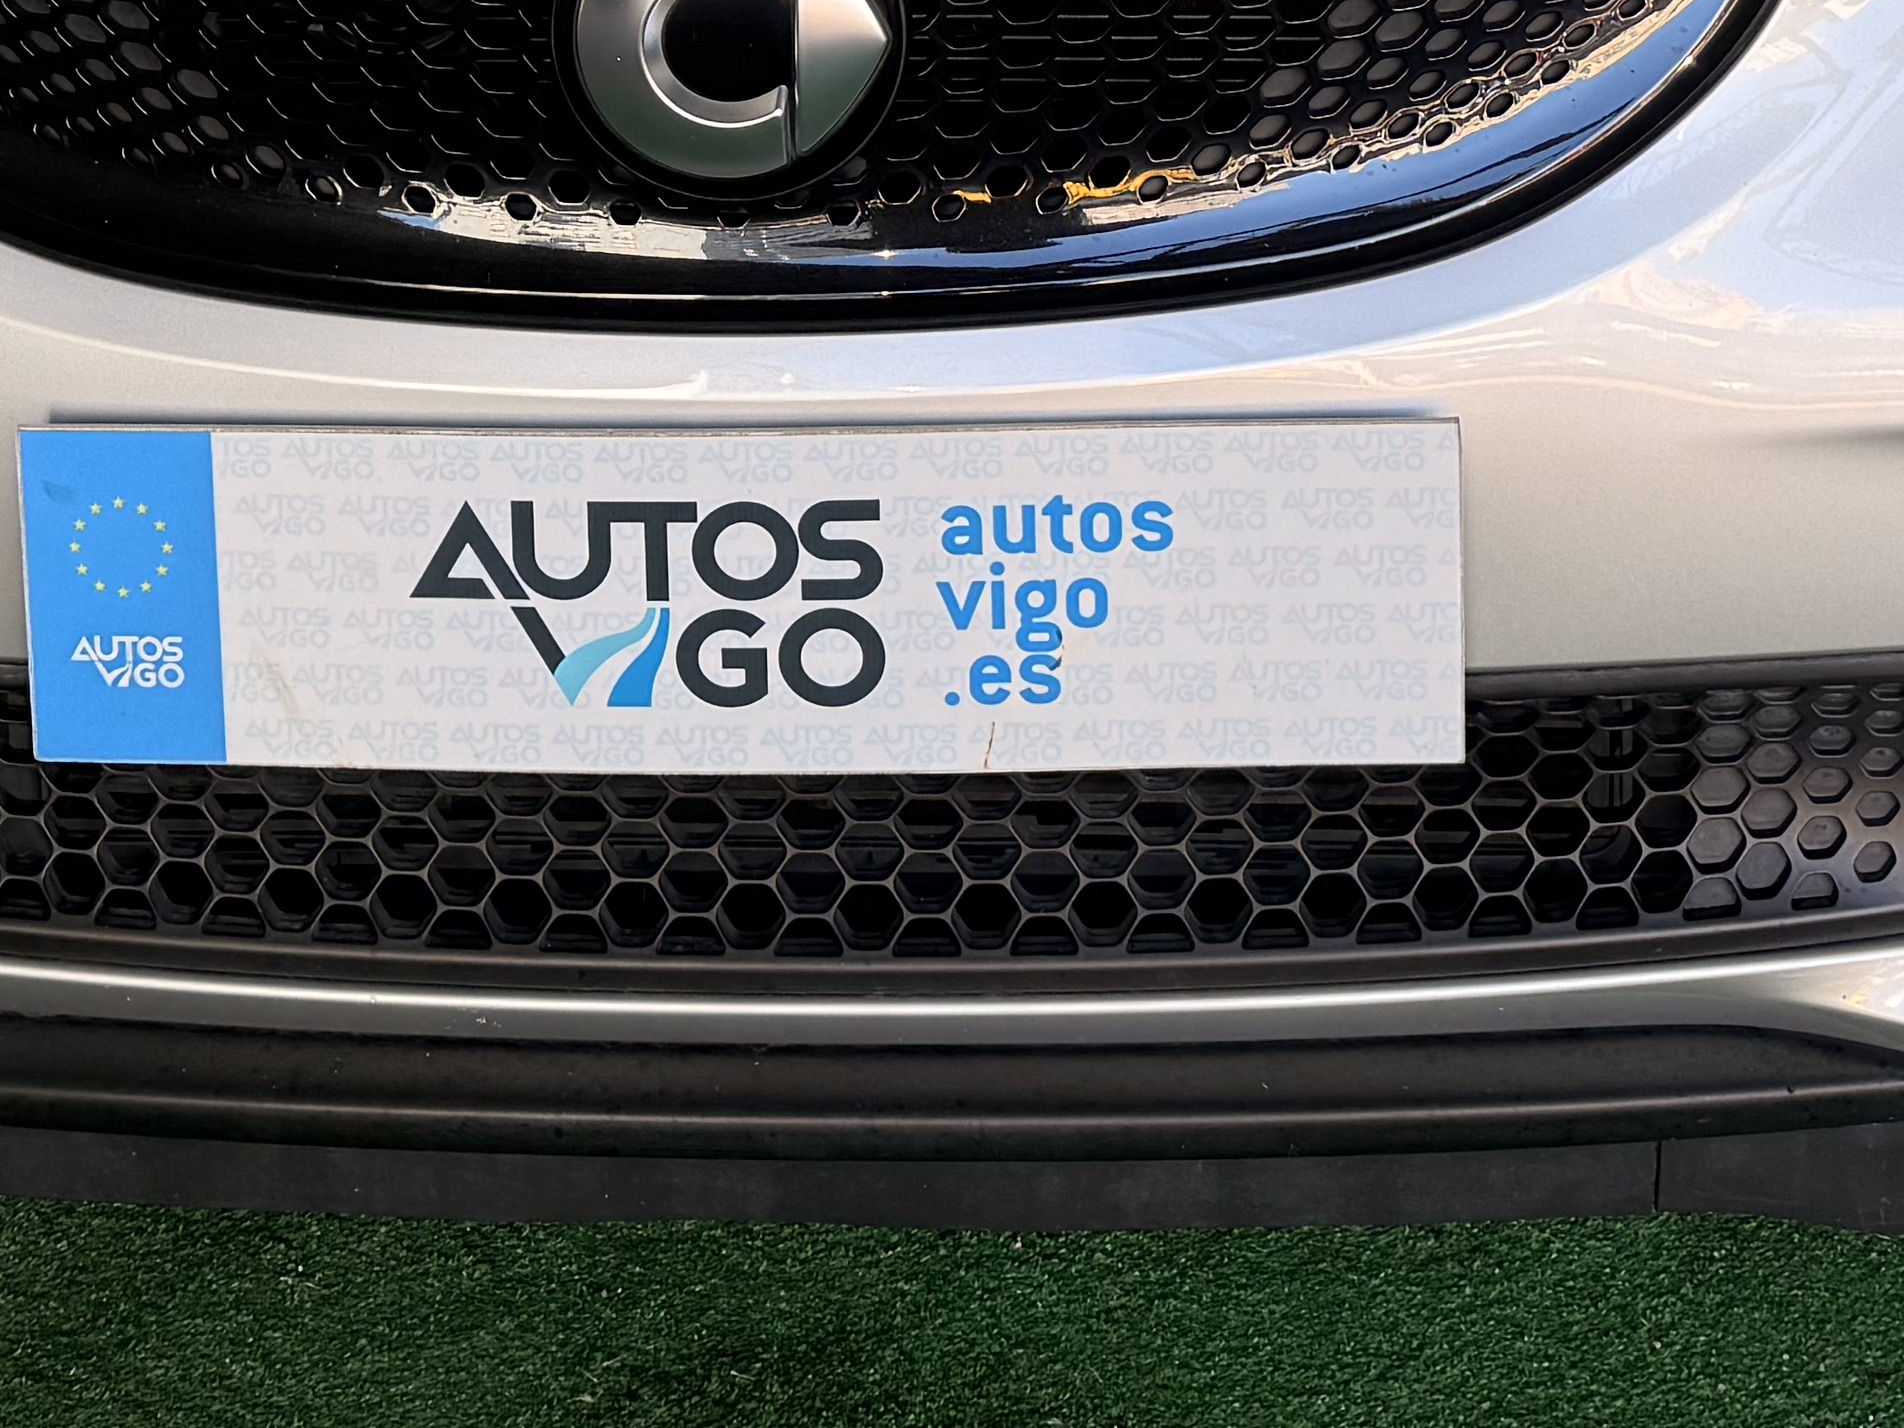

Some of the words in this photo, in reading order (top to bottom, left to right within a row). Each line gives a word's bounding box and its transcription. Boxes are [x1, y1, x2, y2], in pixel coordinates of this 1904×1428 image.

[281, 437, 373, 459] AUTOS
[386, 440, 479, 462] AUTOS
[489, 441, 583, 463] AUTOS
[593, 441, 687, 463] AUTOS
[698, 440, 792, 462] AUTOS
[803, 439, 897, 462] AUTOS
[908, 435, 1002, 459] AUTOS
[1013, 432, 1109, 456] AUTOS
[1118, 431, 1215, 455] AUTOS
[1223, 430, 1319, 454] AUTOS
[1330, 429, 1426, 453] AUTOS
[234, 493, 325, 515] AUTOS
[337, 495, 430, 516] AUTOS
[1176, 489, 1268, 511] AUTOS
[1280, 488, 1374, 510] AUTOS
[940, 494, 1175, 556] autos
[409, 498, 884, 602] AUTOS
[935, 561, 1109, 653] vigo
[70, 635, 184, 663] AUTOS
[511, 606, 887, 709] VIGO
[94, 661, 186, 689] VIGO
[944, 653, 1064, 707] .es
[449, 724, 541, 745] AUTOS
[551, 724, 644, 746] AUTOS
